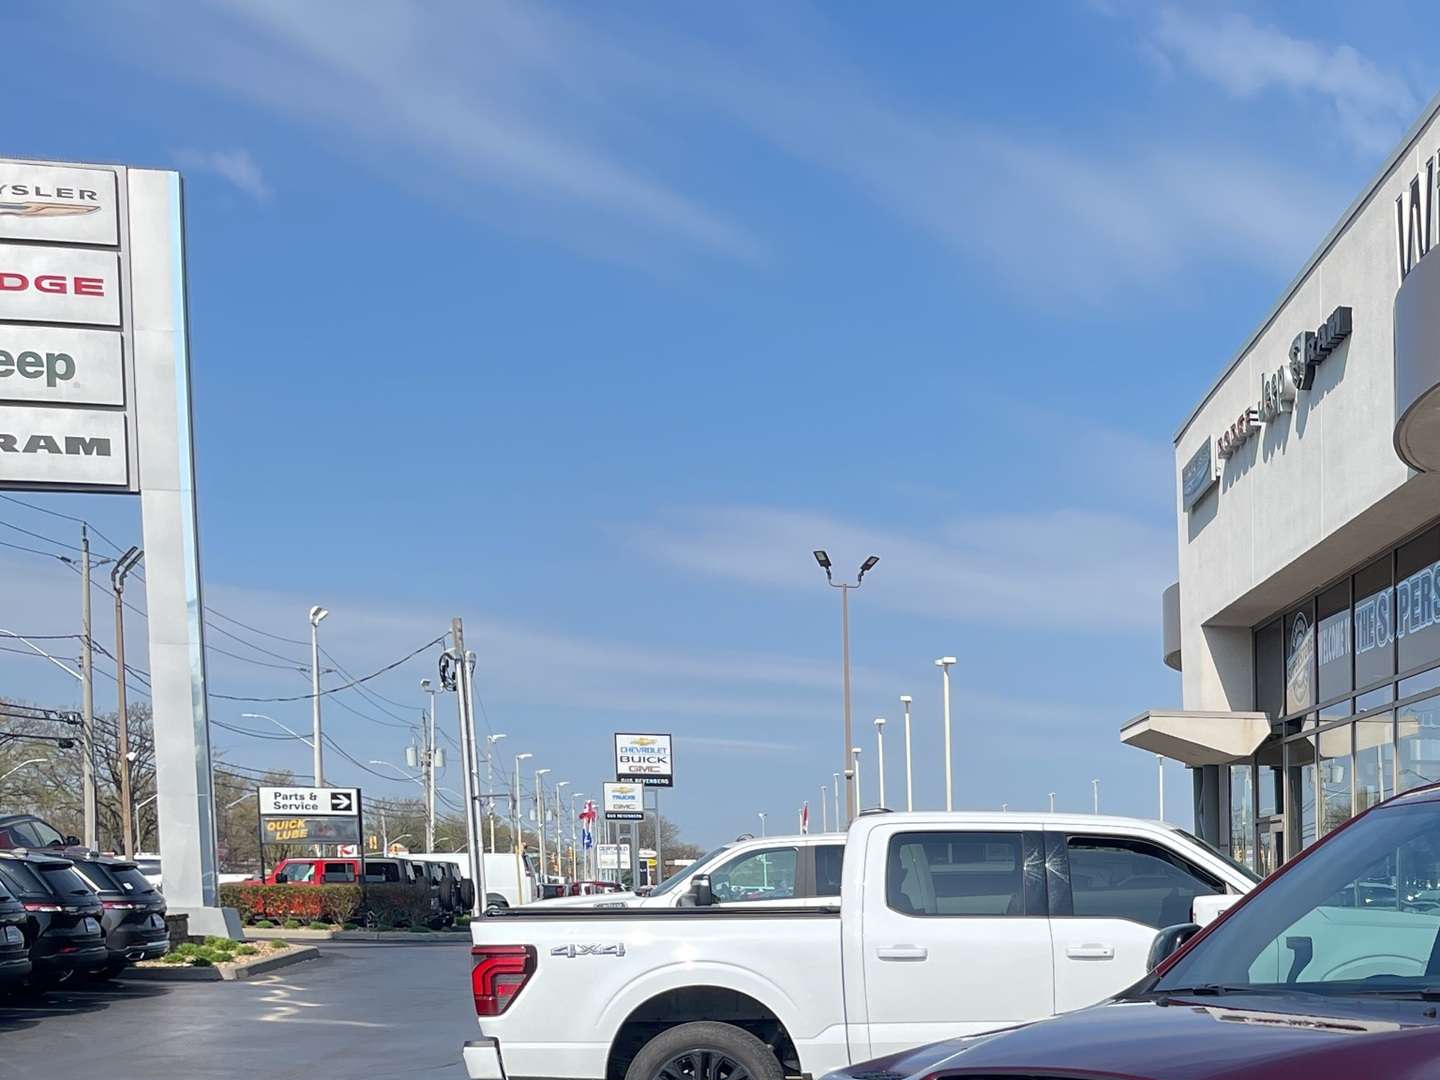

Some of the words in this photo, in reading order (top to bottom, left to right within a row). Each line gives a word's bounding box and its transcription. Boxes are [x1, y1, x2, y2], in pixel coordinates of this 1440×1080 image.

[620, 756, 668, 764] BUICK
[629, 765, 661, 773] GMC
[273, 791, 305, 801] Parts
[309, 792, 317, 801] &
[273, 801, 319, 810] Service
[267, 819, 306, 832] QUICK
[276, 828, 308, 841] LUBE
